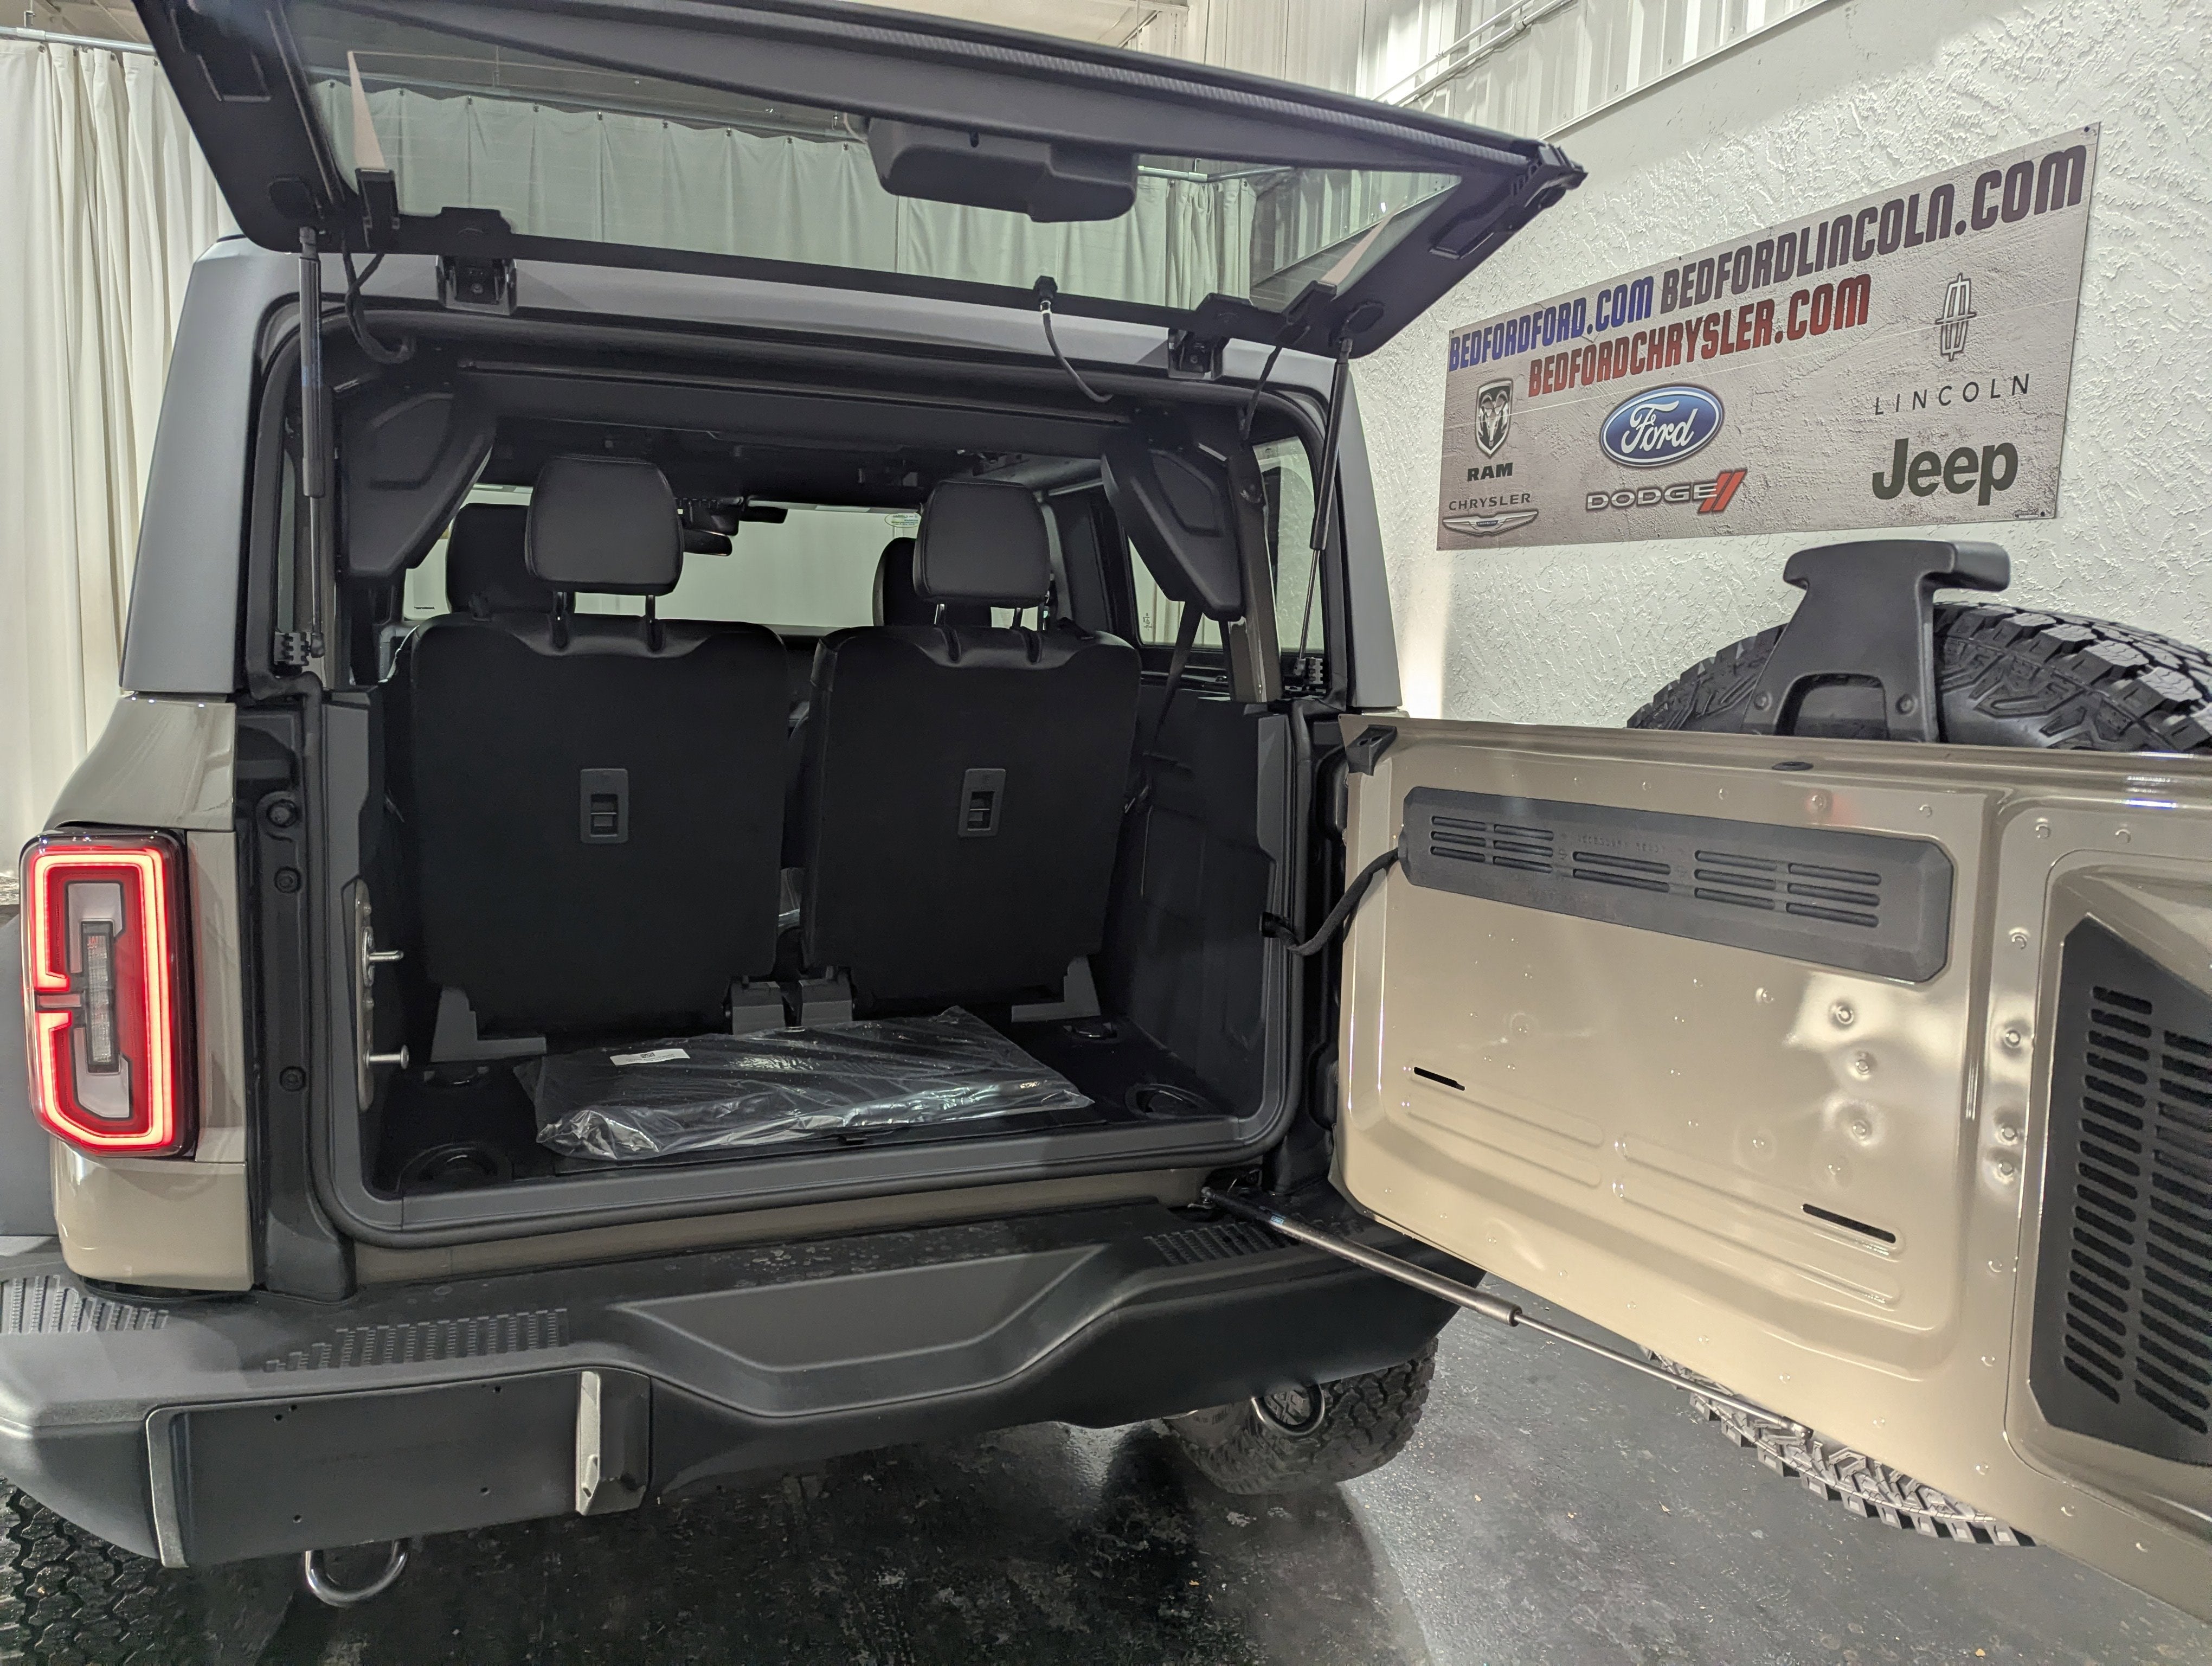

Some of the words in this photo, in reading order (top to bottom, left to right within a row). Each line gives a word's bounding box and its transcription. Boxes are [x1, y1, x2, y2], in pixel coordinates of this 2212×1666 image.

[1449, 276, 1654, 371] BEDFORDFORD.COM
[1661, 145, 2086, 314] BEDFORDLINCOLN.COM
[1528, 273, 1872, 398] BEDFORDCHRYSLER.COM
[1875, 373, 2029, 415] LINCOLN
[1621, 400, 1699, 453] Ford
[1467, 463, 1513, 482] RAM
[1872, 438, 2018, 506] Jeep
[1449, 493, 1531, 510] CHRYSLER
[1586, 482, 1718, 510] DODGE
